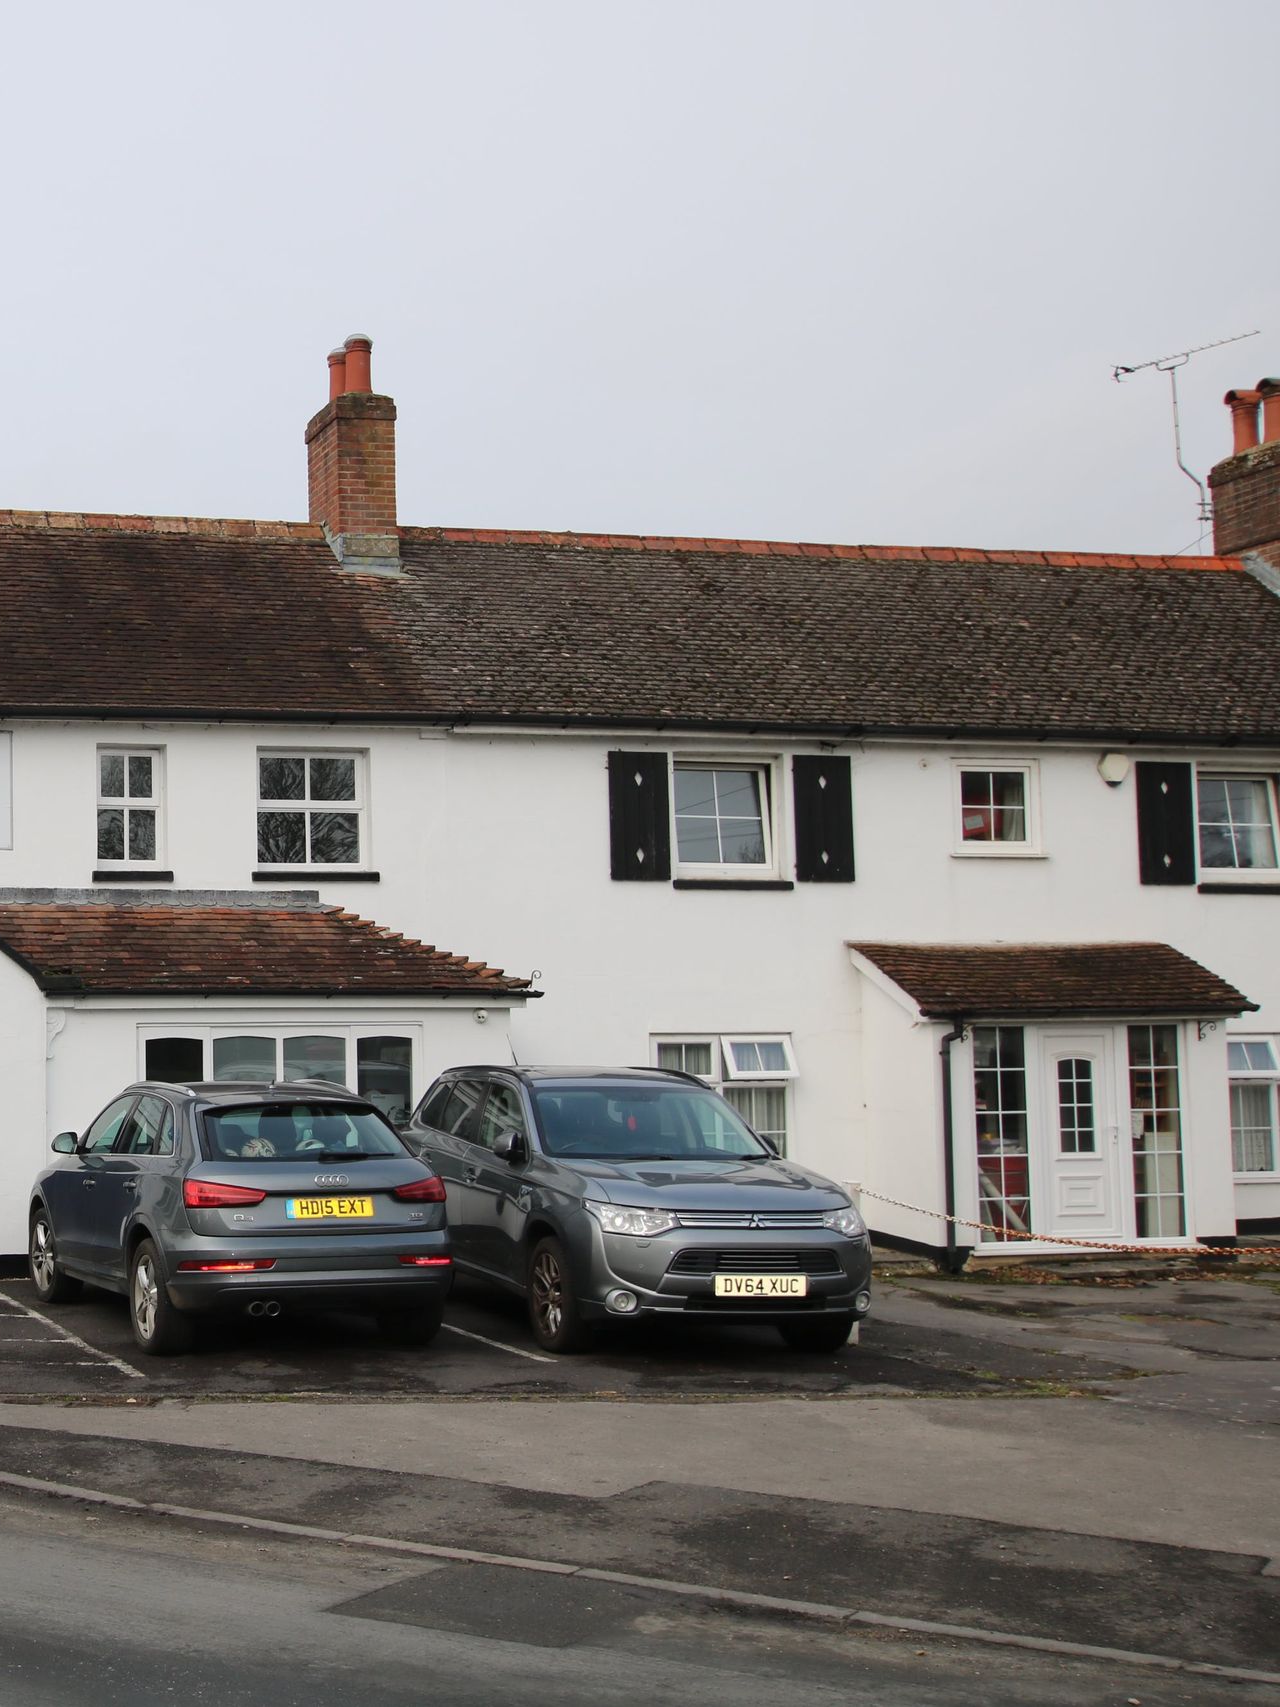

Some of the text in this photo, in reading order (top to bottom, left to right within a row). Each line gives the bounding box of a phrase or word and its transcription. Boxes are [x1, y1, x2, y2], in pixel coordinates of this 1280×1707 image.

[300, 1199, 366, 1215] HD15 EXT
[724, 1278, 799, 1293] DV64 XUC
